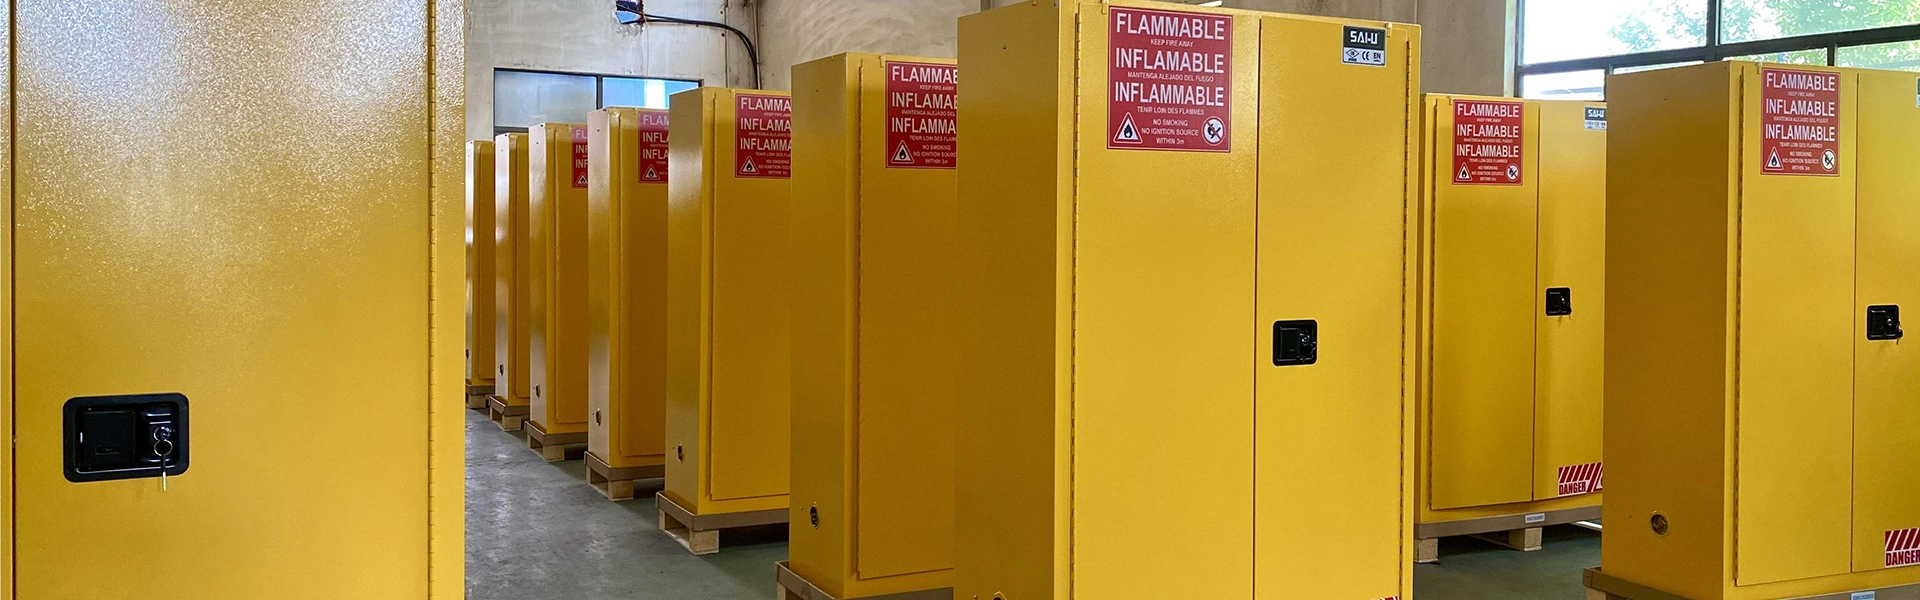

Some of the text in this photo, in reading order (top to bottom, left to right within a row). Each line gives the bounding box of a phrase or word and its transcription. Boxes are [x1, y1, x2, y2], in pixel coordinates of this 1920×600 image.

[1117, 13, 1224, 40] FLAMMABLE
[1116, 48, 1224, 73] INFLAMABLE
[1766, 73, 1835, 91] FLAMMABLE
[1115, 82, 1224, 106] INFLAMMABLE
[1458, 104, 1519, 117] FLAMMABLE
[1766, 99, 1835, 116] INFLAMABLE
[1457, 124, 1519, 137] INFLAMABLE
[1766, 124, 1835, 141] INFLAMMABLE
[1457, 144, 1518, 157] INFLAMMABLE
[1559, 482, 1586, 495] DANGER
